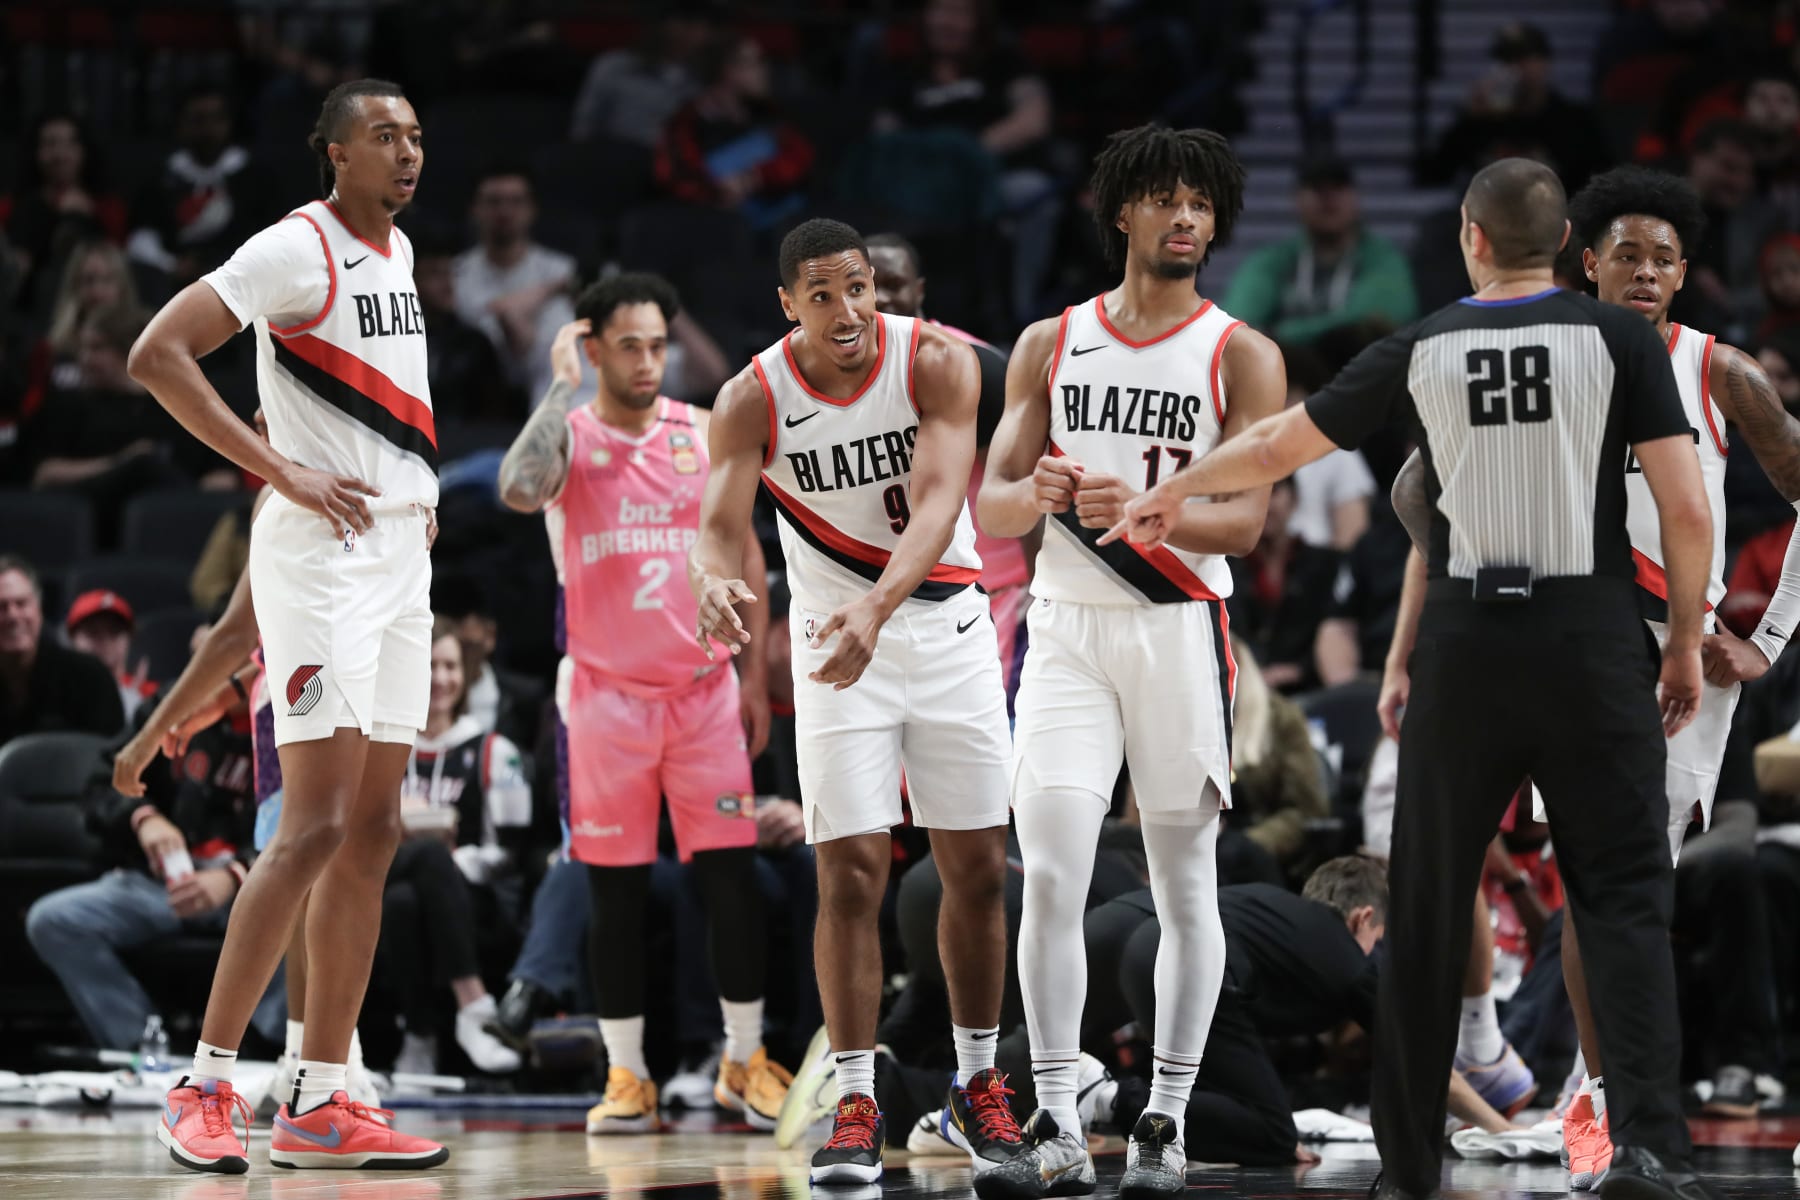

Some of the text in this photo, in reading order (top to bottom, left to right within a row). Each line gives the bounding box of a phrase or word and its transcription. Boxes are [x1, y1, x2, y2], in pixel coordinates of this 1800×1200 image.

[351, 292, 423, 338] BLAZE
[1466, 344, 1552, 426] 28
[1060, 384, 1201, 442] BLAZERS
[1142, 445, 1192, 492] 17
[618, 496, 673, 524] bnz
[883, 481, 911, 535] 9
[632, 557, 671, 610] 2
